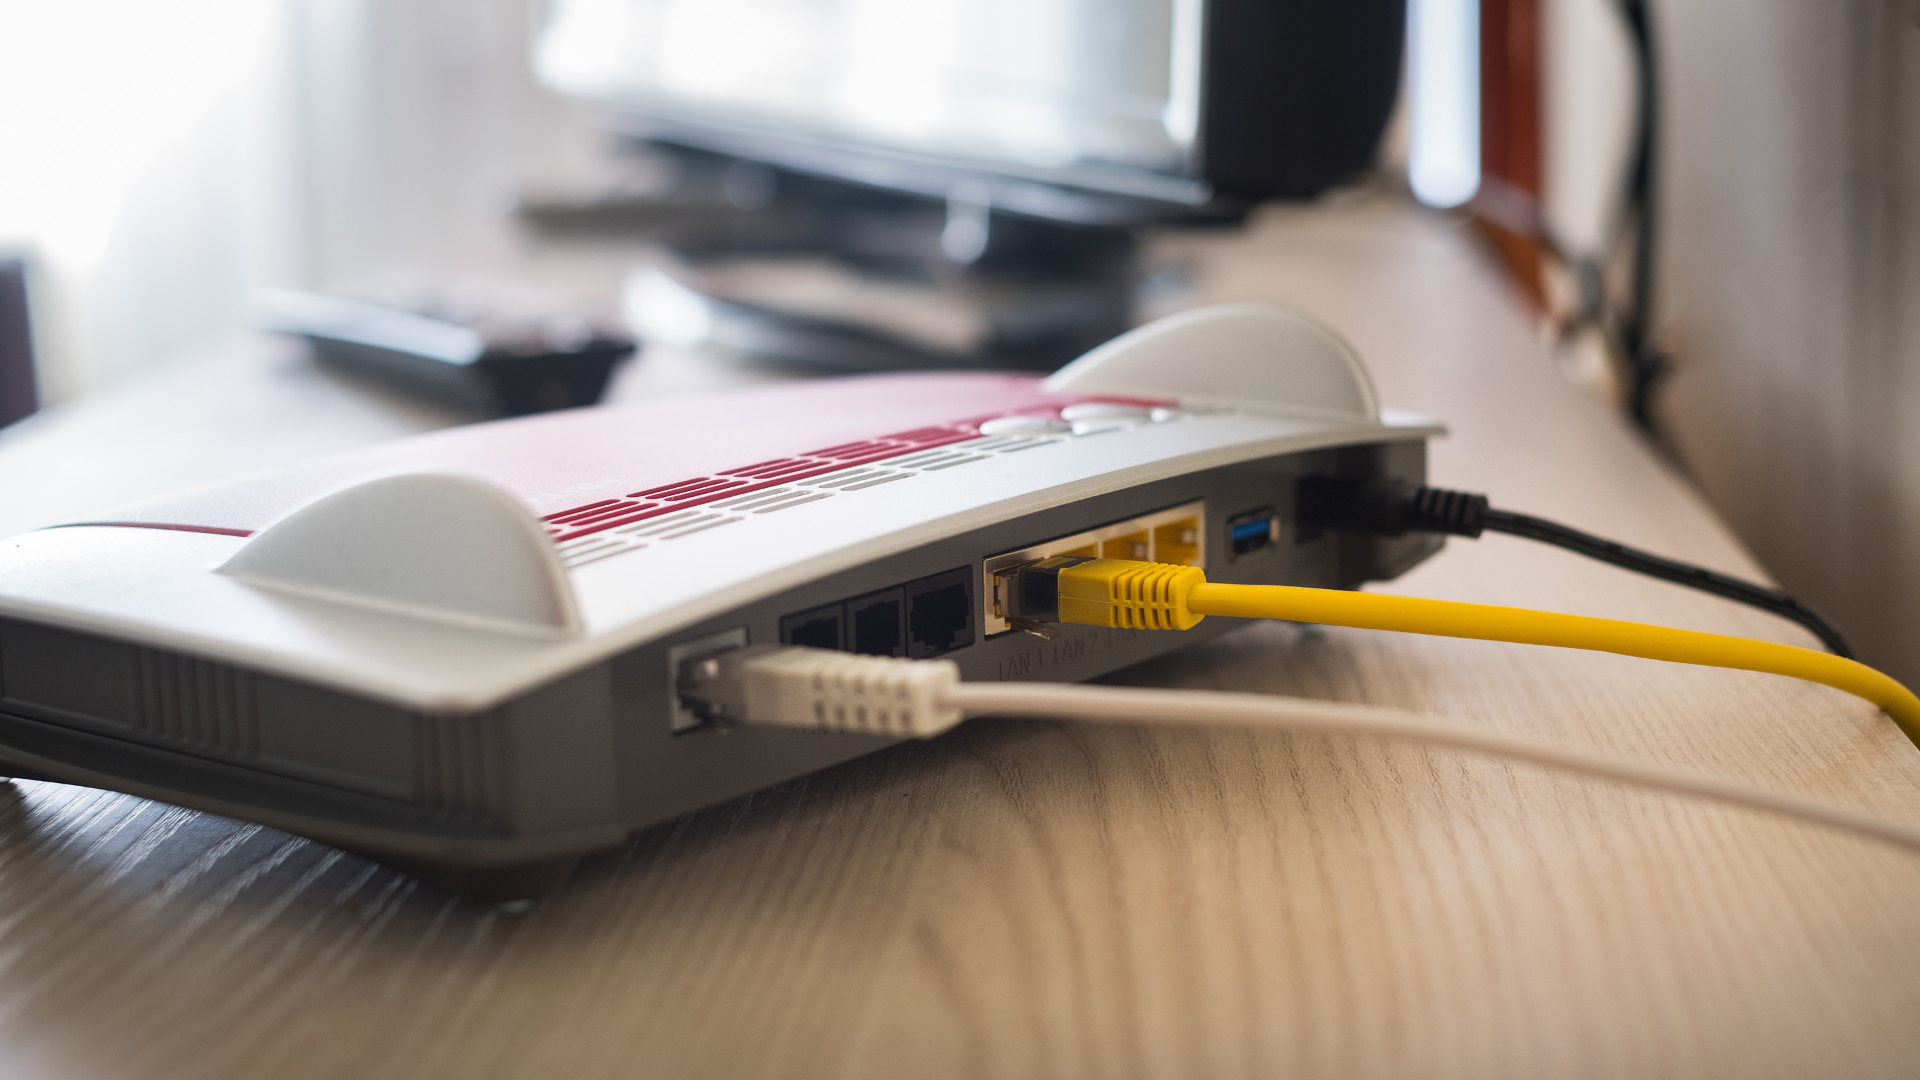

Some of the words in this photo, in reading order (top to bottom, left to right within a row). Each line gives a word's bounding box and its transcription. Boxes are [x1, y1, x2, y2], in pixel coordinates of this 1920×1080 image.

[998, 652, 1032, 681] LAN
[1037, 646, 1044, 669] 1
[1054, 634, 1085, 665] LAN
